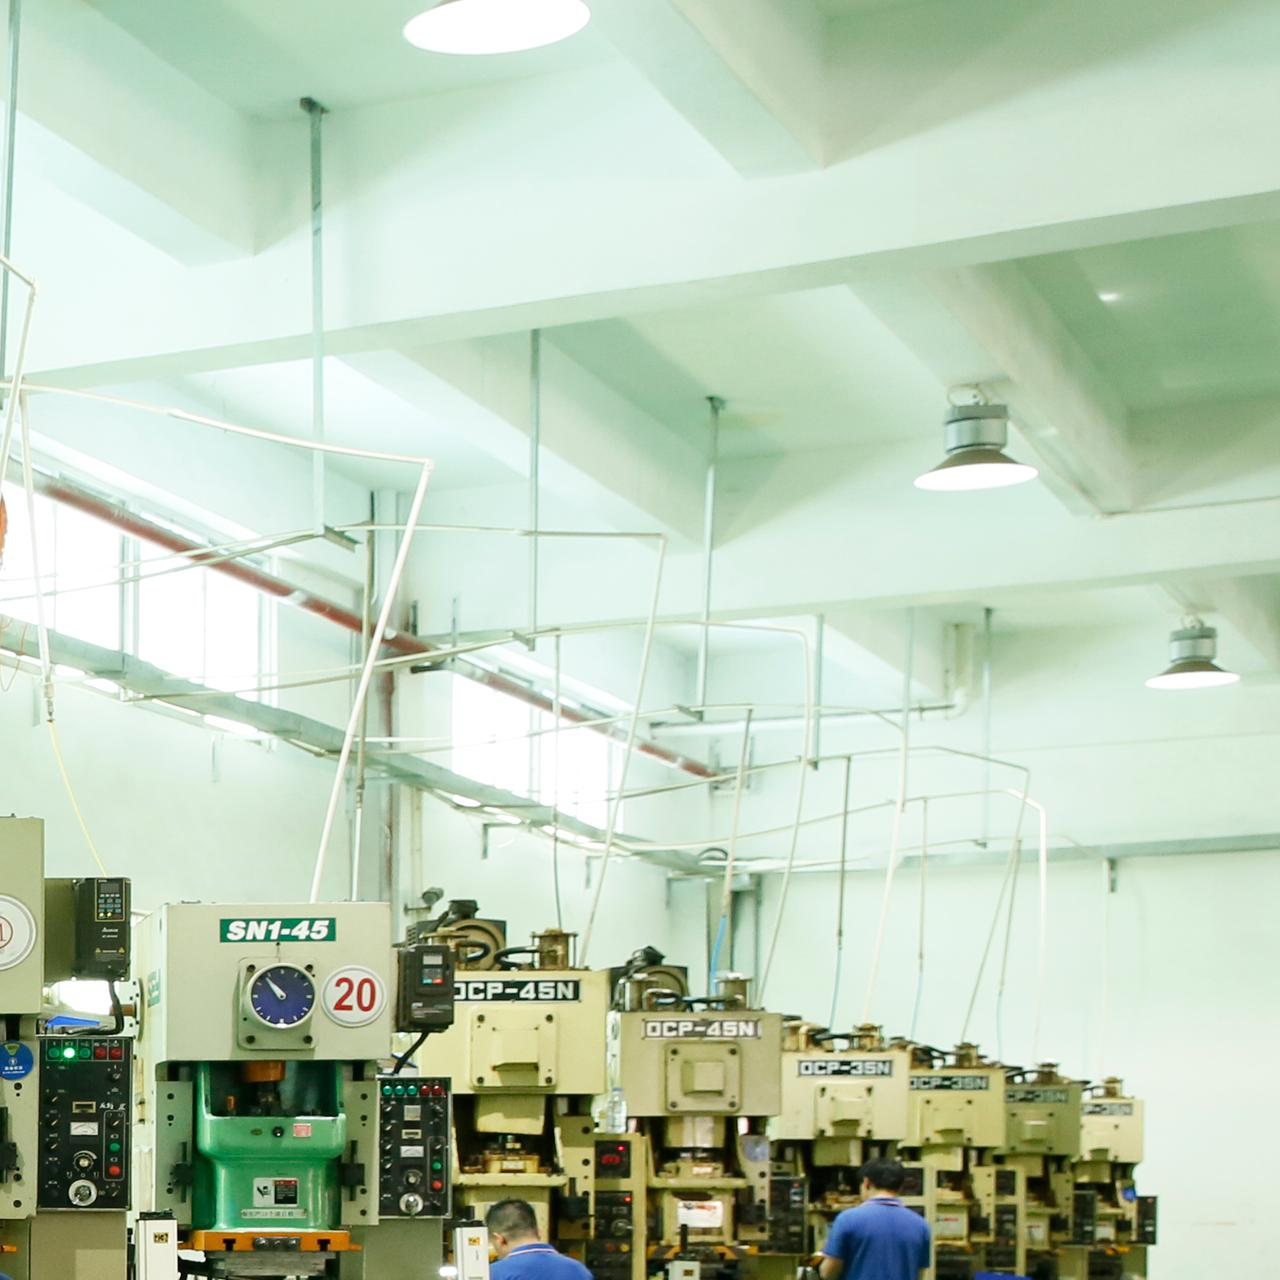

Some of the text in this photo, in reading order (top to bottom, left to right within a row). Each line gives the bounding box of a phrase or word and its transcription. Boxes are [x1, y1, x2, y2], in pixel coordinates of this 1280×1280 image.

[225, 919, 331, 942] SN1-45
[333, 978, 377, 1012] 20
[645, 1021, 756, 1037] OCP-45N
[800, 1061, 891, 1075] OCP-35N
